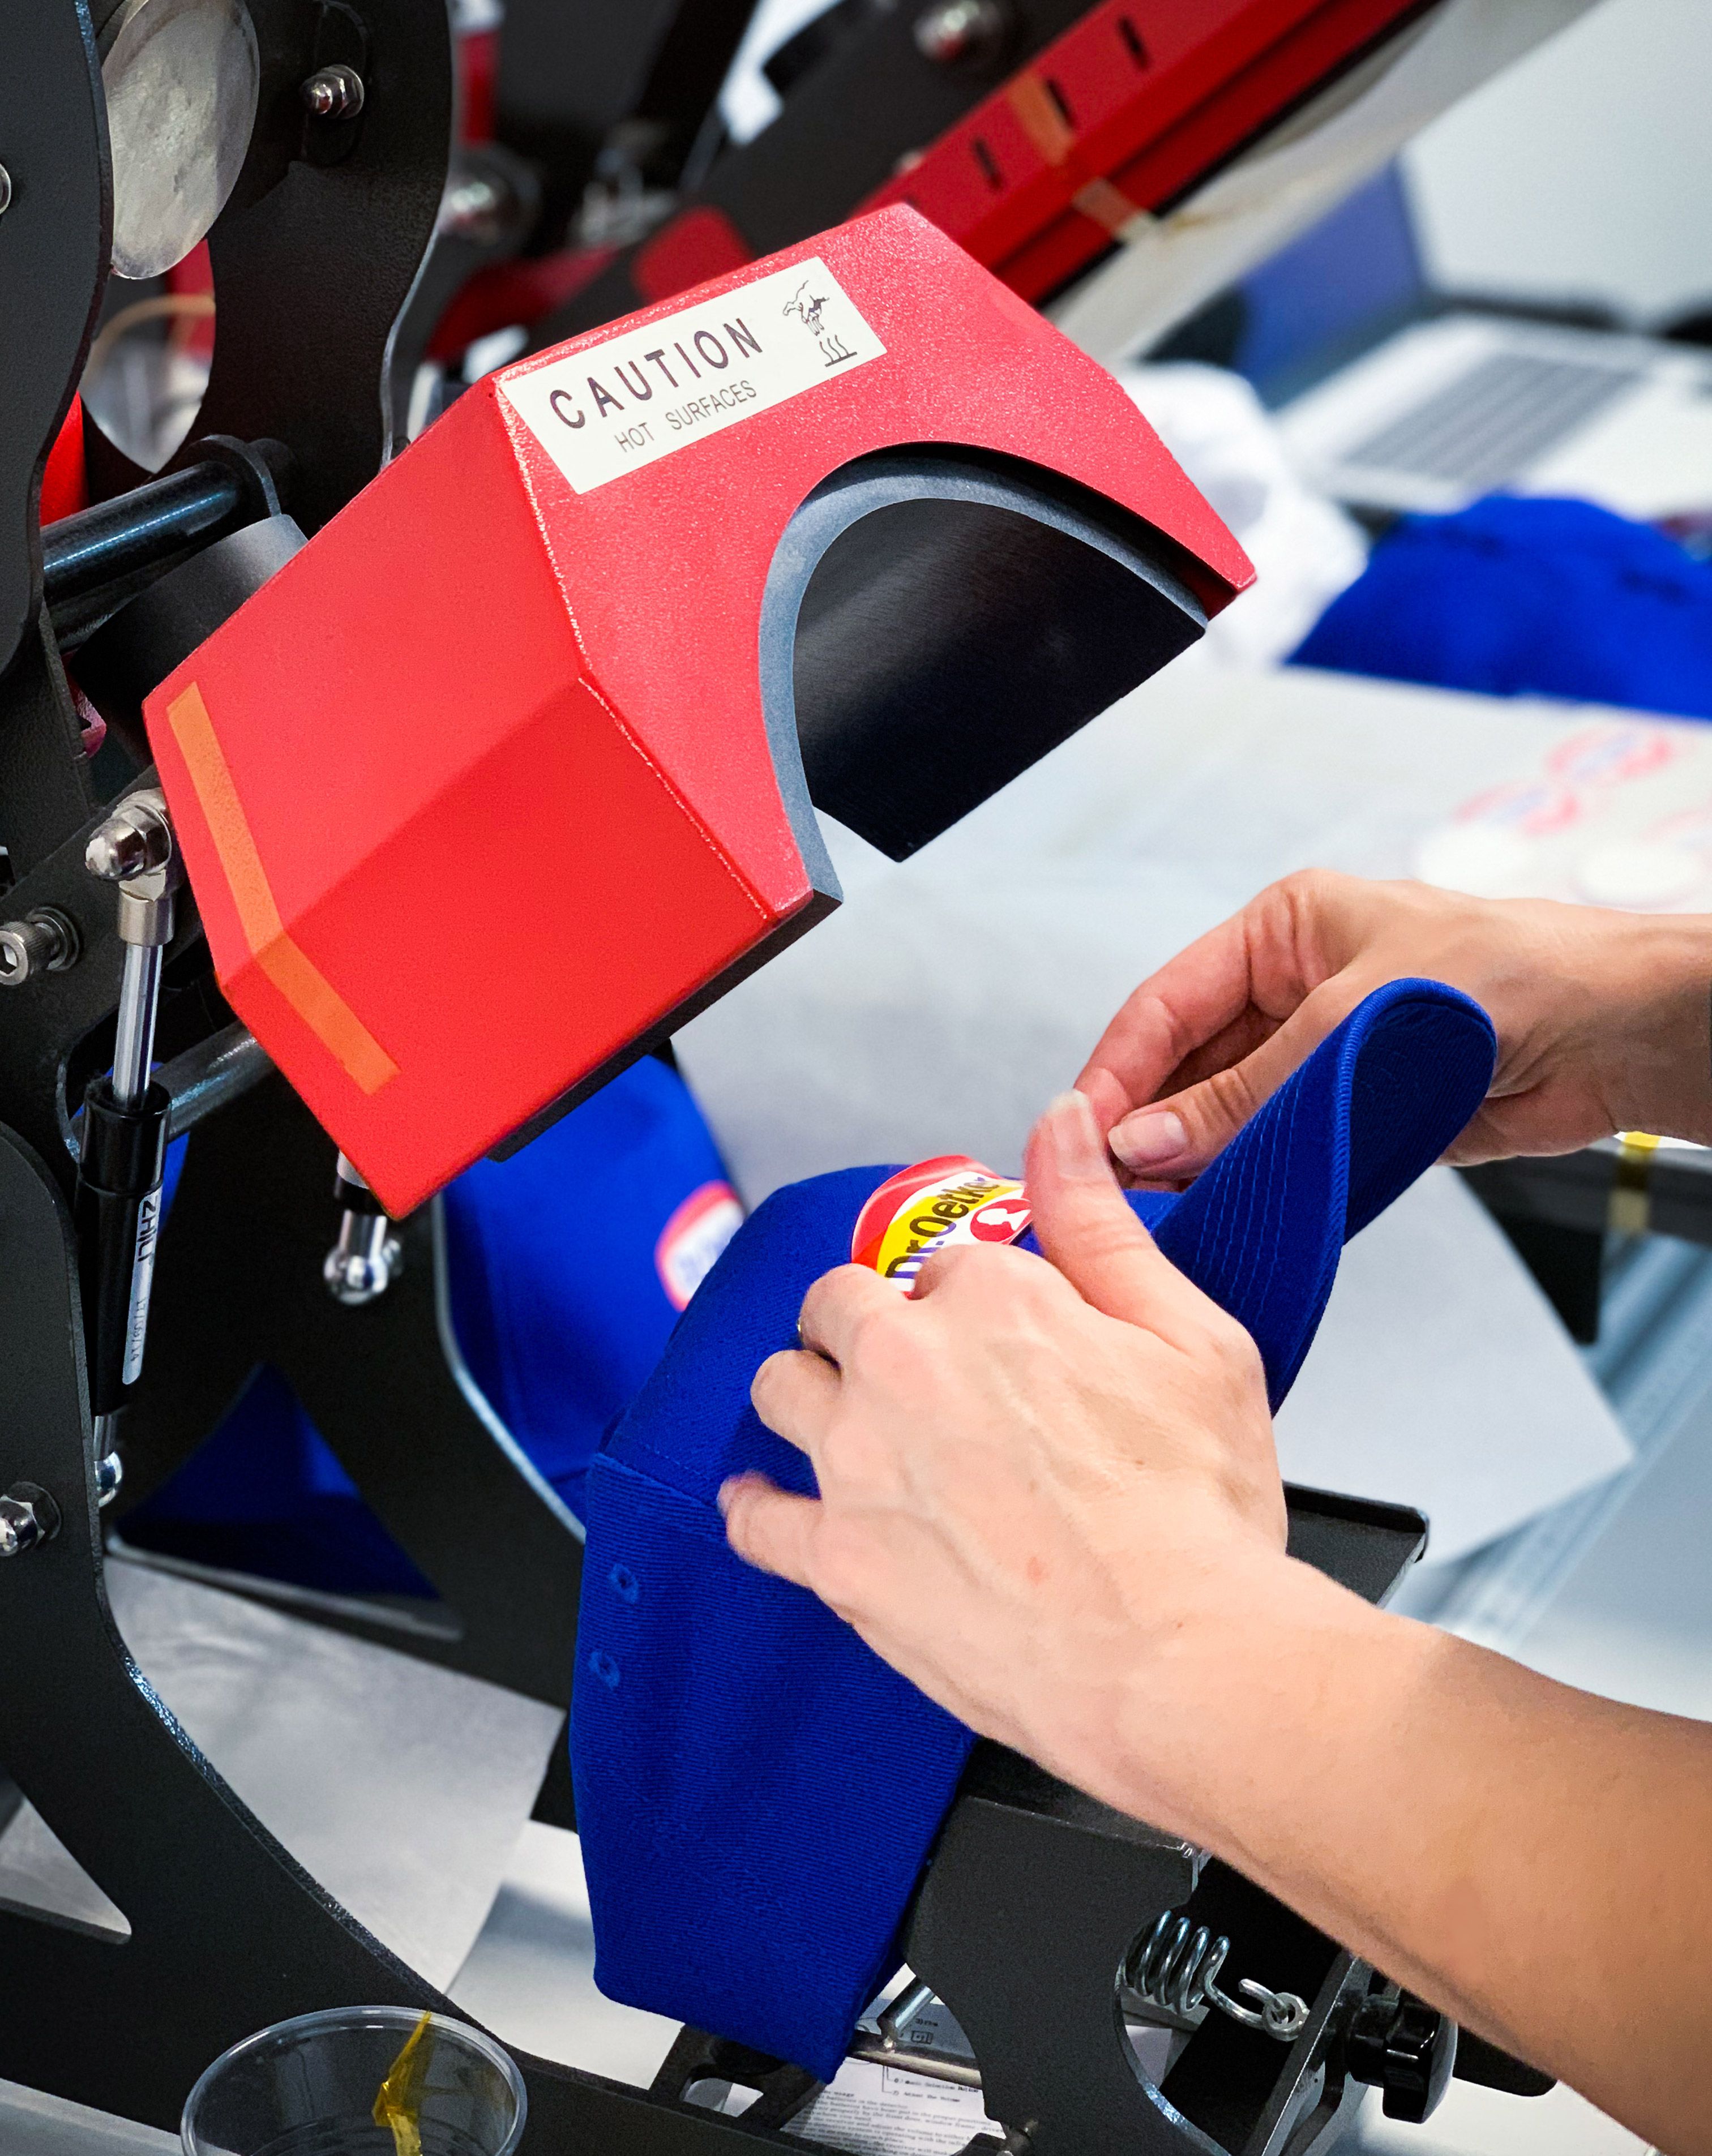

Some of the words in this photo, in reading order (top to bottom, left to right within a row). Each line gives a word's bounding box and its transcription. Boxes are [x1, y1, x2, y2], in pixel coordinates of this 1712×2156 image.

[549, 318, 763, 429] CAUTION
[614, 422, 655, 453] HOT
[665, 380, 757, 431] SURFACES
